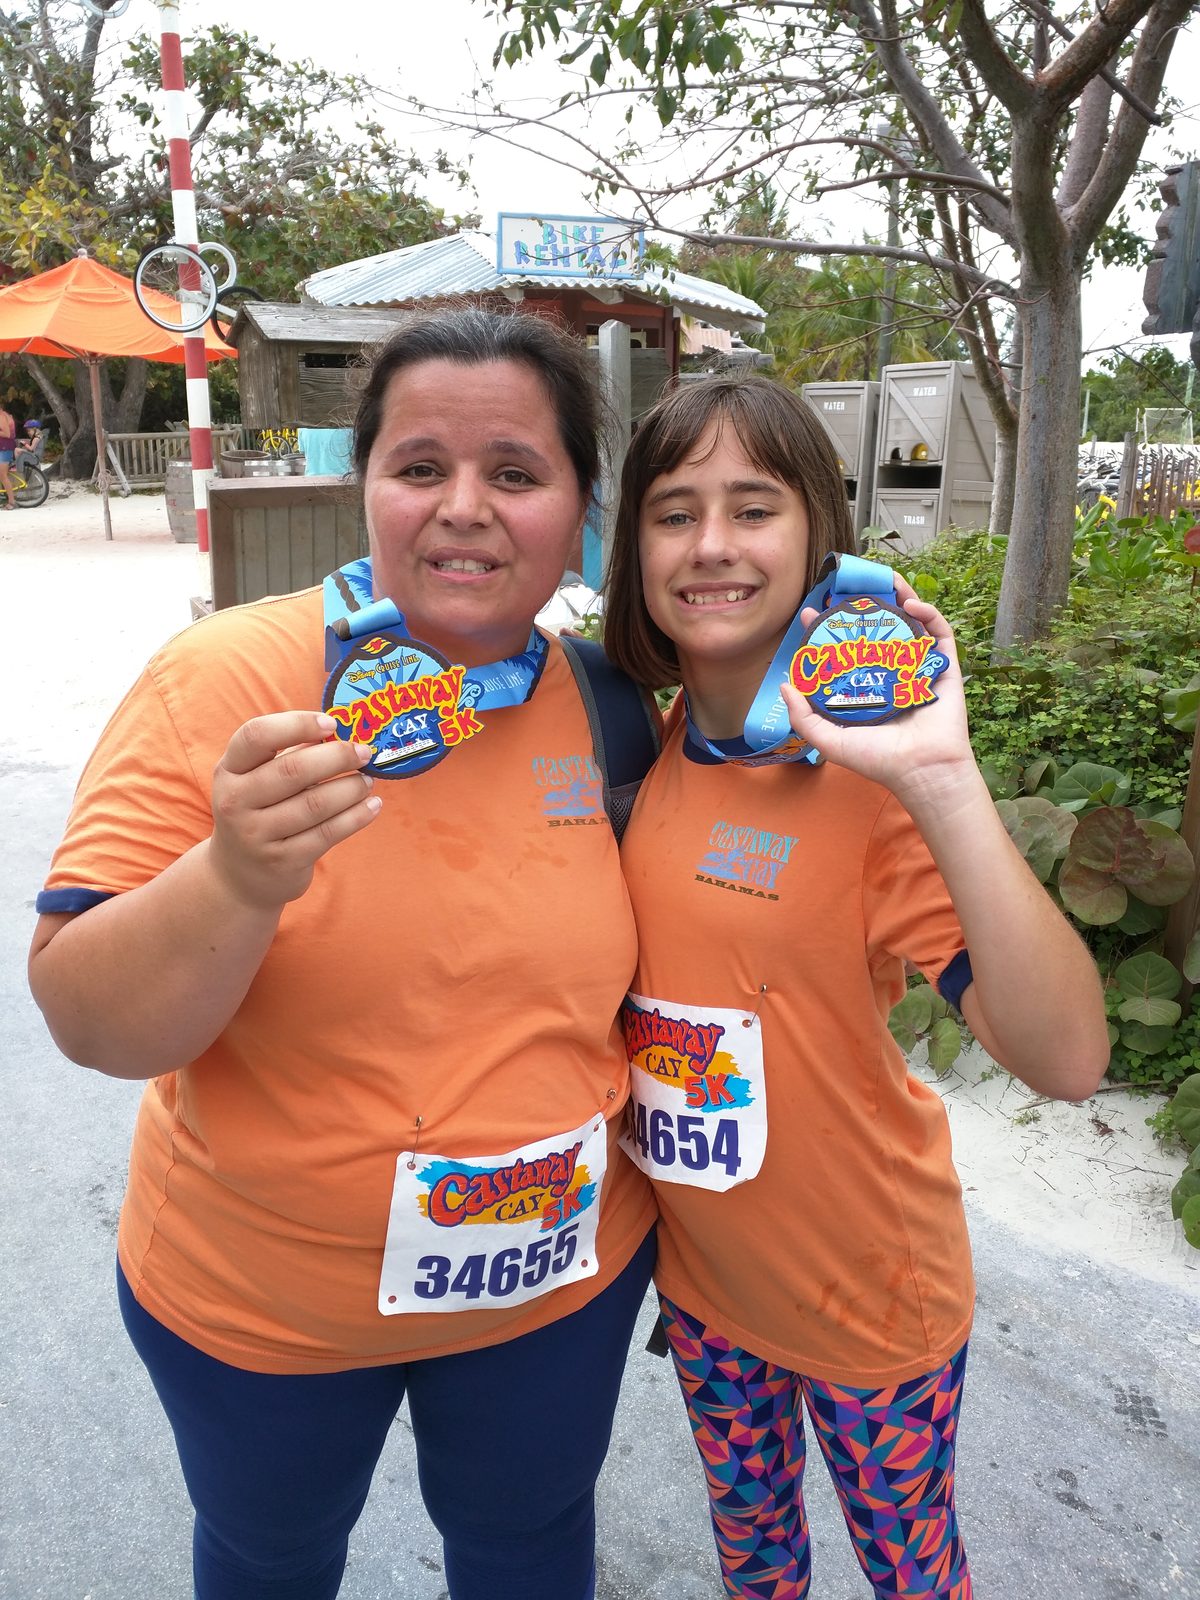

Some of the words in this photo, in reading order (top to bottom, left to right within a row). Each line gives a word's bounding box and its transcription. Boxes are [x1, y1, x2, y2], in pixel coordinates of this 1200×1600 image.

[543, 223, 604, 245] BIKE
[514, 240, 627, 268] RENTAL
[913, 386, 937, 396] WATER
[823, 401, 845, 411] WATER
[903, 515, 925, 525] TRASH
[850, 672, 887, 687] CAY
[893, 676, 939, 709] 5K
[392, 713, 428, 738] CAY
[437, 708, 484, 746] 5K
[694, 874, 780, 901] BAHAMAS
[646, 1052, 682, 1078] CAY
[684, 1073, 736, 1108] 5K
[631, 1102, 742, 1177] 4654
[495, 1193, 545, 1221] CAY
[540, 1186, 583, 1230] 5K
[414, 1223, 580, 1300] 34655
